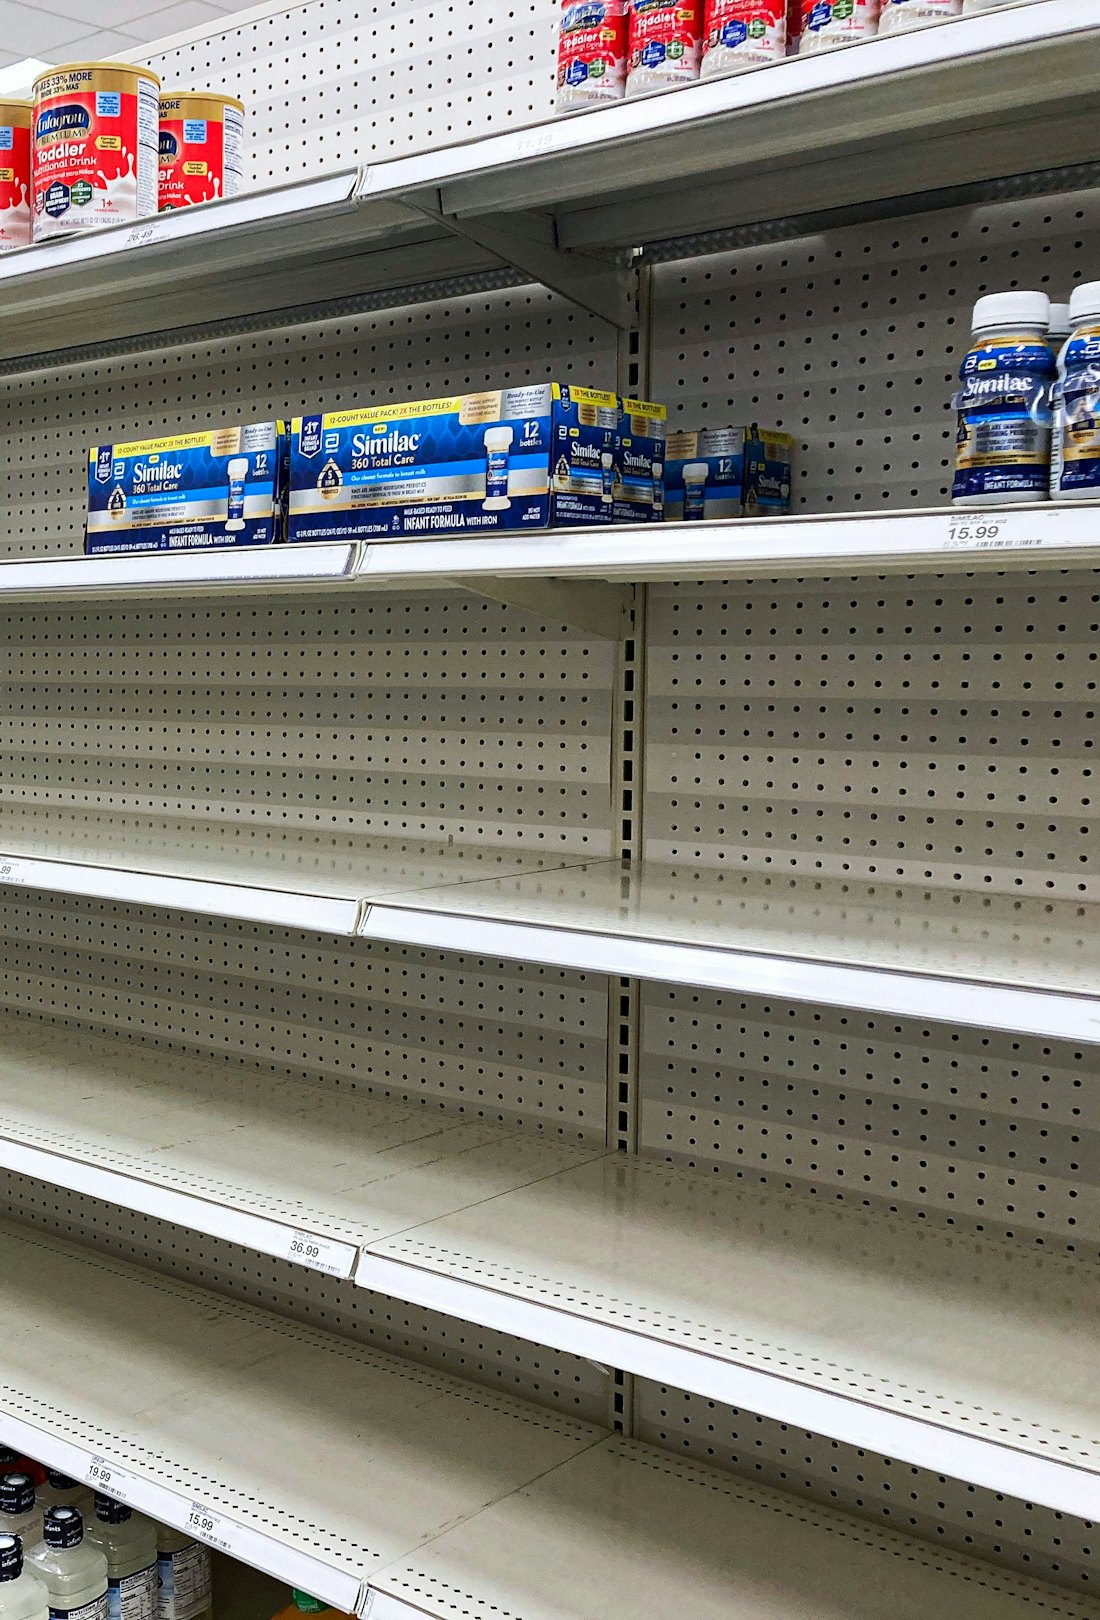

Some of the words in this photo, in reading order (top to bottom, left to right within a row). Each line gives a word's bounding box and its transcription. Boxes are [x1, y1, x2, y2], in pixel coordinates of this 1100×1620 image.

[563, 33, 598, 49] Toddler
[51, 74, 68, 88] 33%
[69, 71, 93, 81] MORE
[37, 142, 86, 165] Toddler
[69, 156, 97, 167] Drink
[158, 180, 184, 191] Drink
[102, 199, 113, 208] 1+
[963, 373, 1033, 397] Similac
[580, 390, 589, 398] THE
[359, 411, 379, 420] VALUE
[399, 407, 408, 415] 2X
[408, 405, 421, 413] THE
[523, 420, 540, 438] 12
[352, 430, 420, 457] Similac
[519, 438, 542, 447] bottles
[571, 441, 601, 459] Similac
[255, 454, 268, 469] 12
[352, 459, 369, 469] 360
[371, 456, 391, 468] Total
[394, 454, 415, 465] Care
[623, 451, 651, 468] Similac
[718, 459, 732, 473] 12
[133, 460, 183, 483] Similac
[133, 484, 146, 495] 360
[147, 482, 162, 493] Total
[163, 480, 179, 491] Care
[404, 515, 430, 530] INFANT
[430, 513, 465, 528] FORMULA
[466, 516, 482, 526] WITH
[948, 526, 999, 540] 15.99
[290, 1240, 319, 1258] 36.99
[89, 1465, 111, 1482] 19.99
[189, 1512, 213, 1531] 15.99
